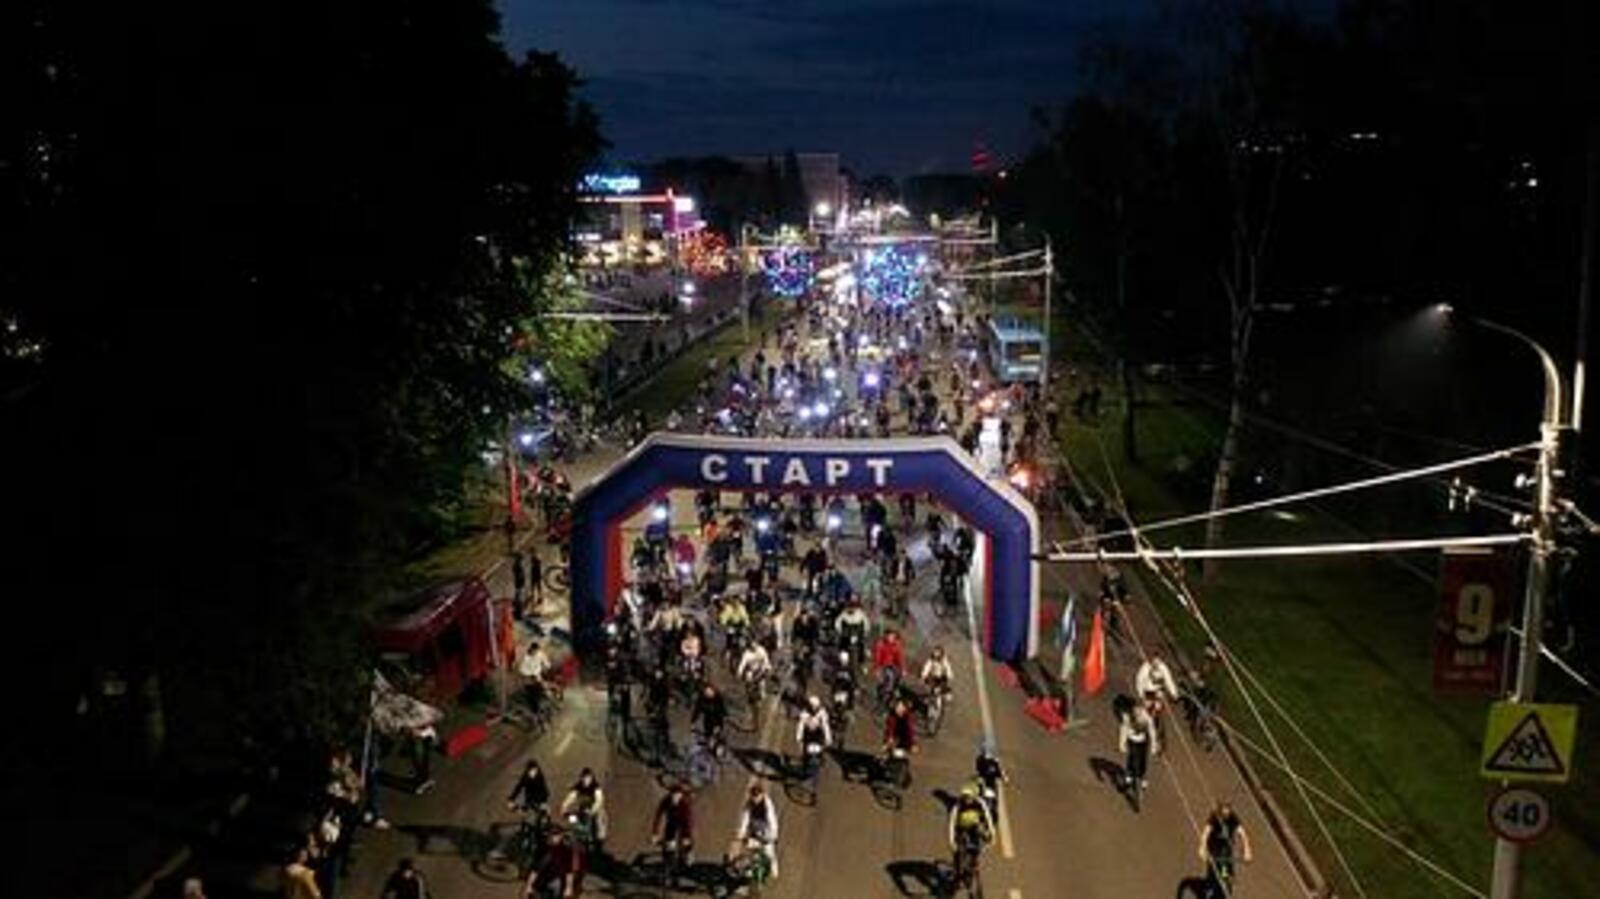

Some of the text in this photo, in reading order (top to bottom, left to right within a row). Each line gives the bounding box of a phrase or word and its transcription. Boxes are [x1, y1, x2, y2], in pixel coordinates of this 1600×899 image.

[701, 454, 893, 486] СТАРТ
[1455, 582, 1494, 645] 9
[1503, 802, 1539, 826] 40
